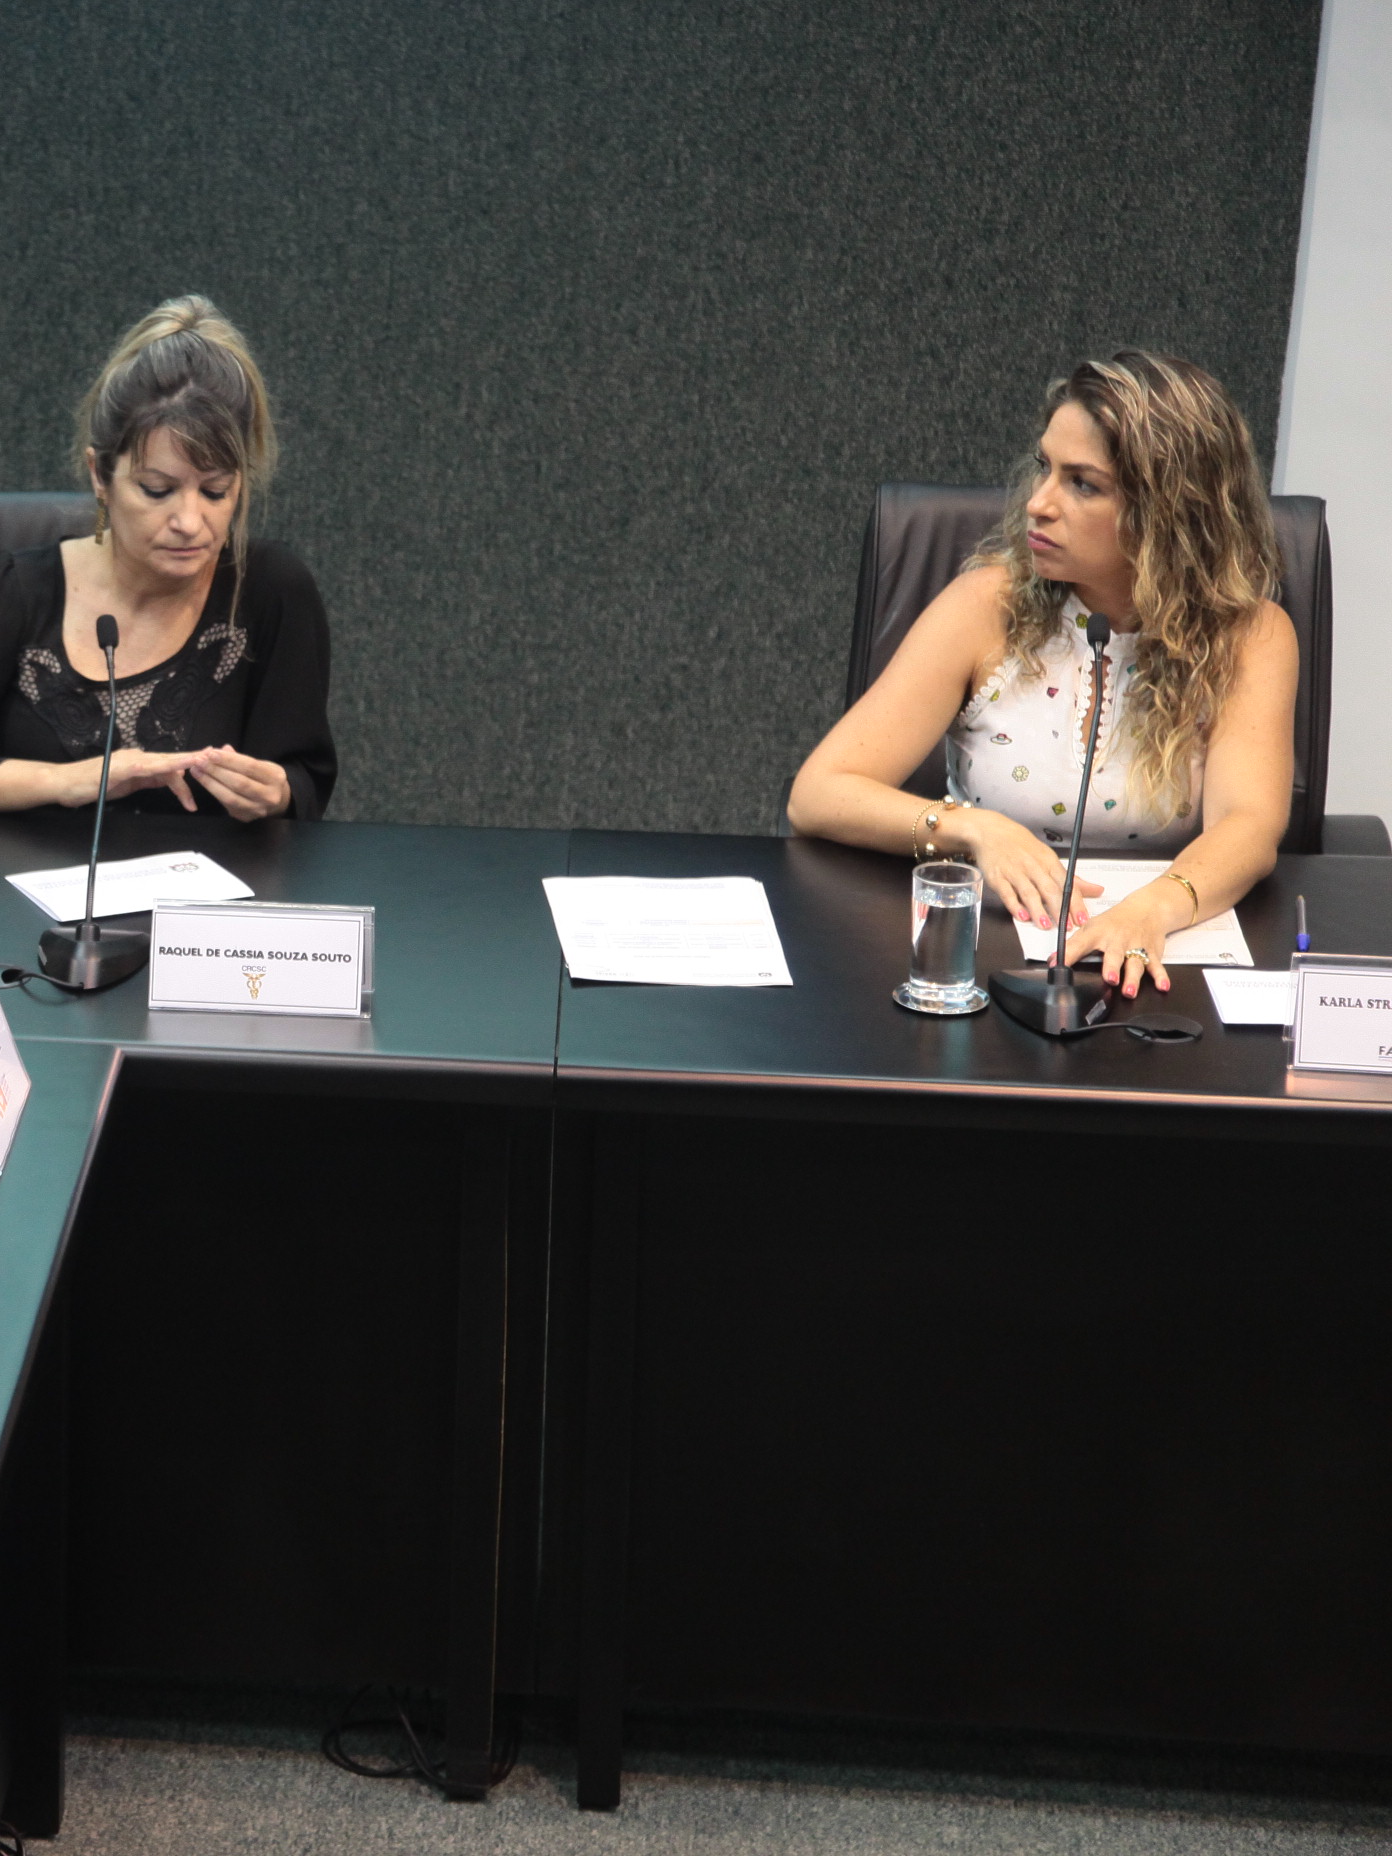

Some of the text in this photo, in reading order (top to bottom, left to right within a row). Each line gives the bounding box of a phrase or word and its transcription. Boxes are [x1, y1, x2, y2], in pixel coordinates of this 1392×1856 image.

[158, 946, 203, 957] RAQUEL
[206, 948, 221, 957] DE
[267, 951, 308, 961] SOUZA
[311, 953, 352, 963] SOUTO
[1319, 996, 1363, 1009] KARLA
